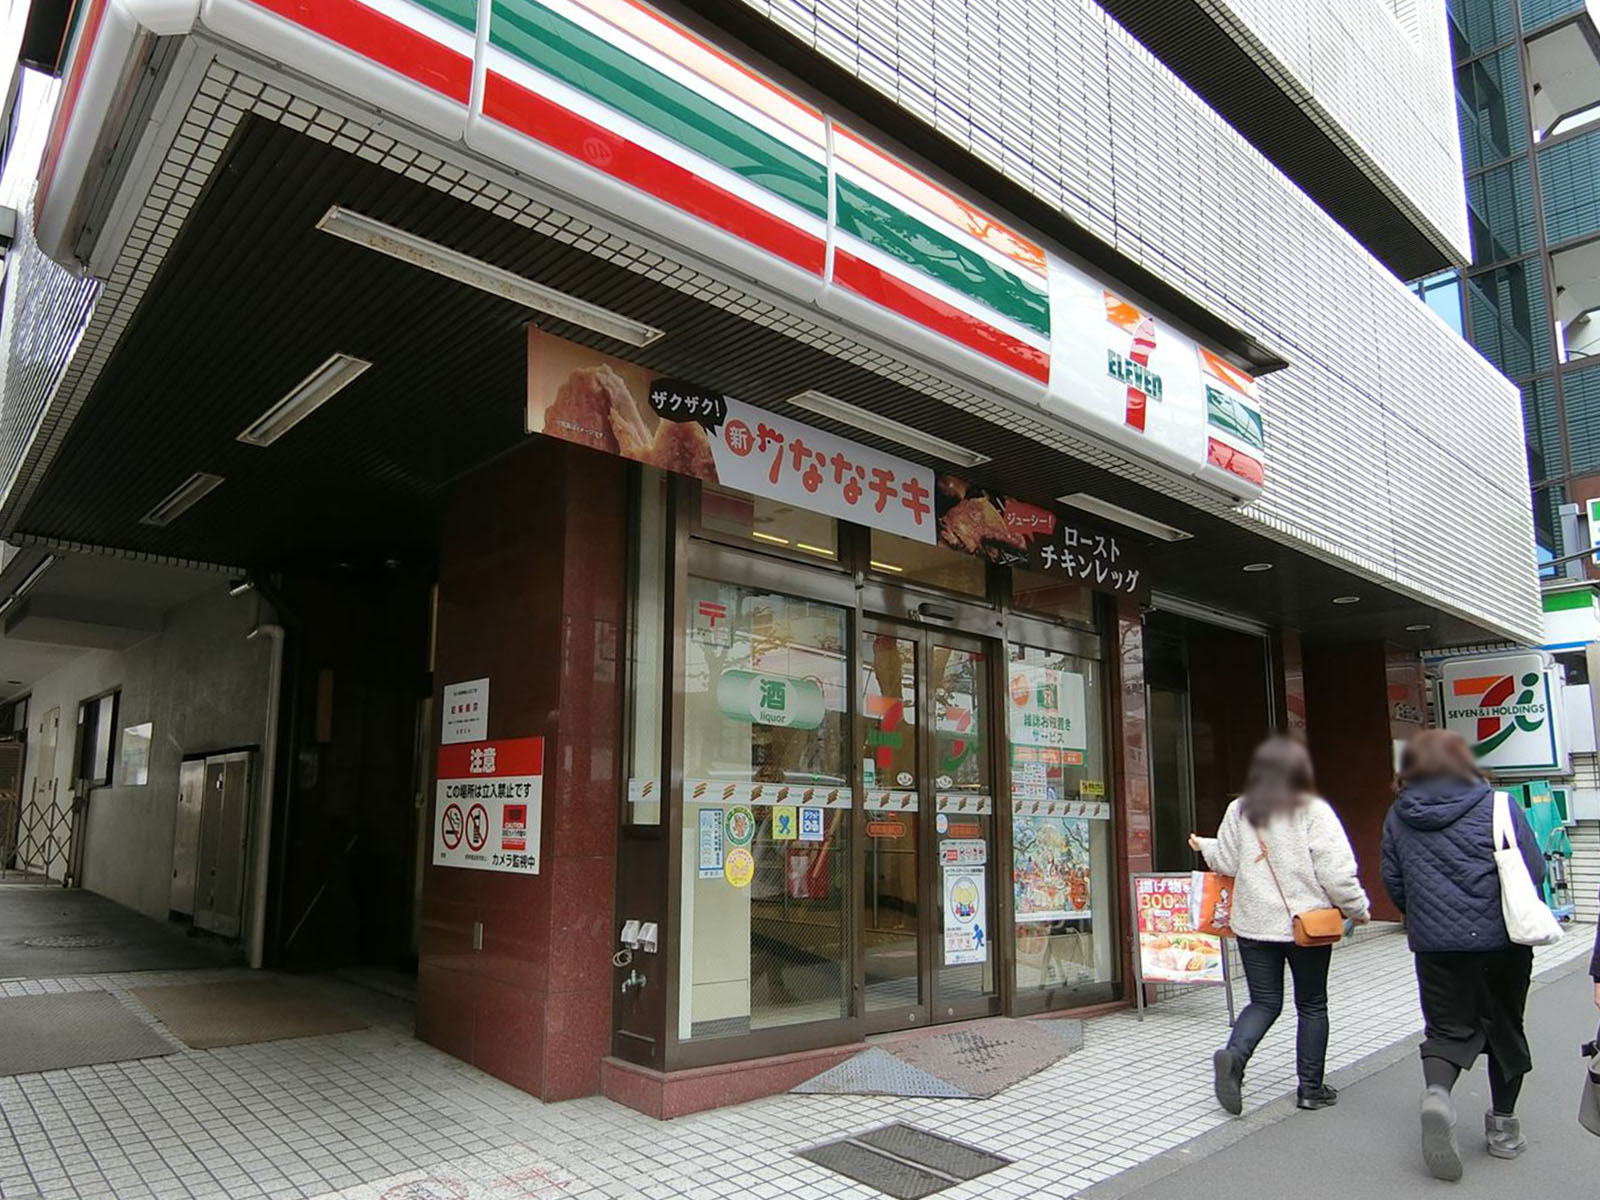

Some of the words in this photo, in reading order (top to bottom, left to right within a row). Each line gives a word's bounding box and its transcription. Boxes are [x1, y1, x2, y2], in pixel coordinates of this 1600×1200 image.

[1107, 349, 1163, 402] ELEVEN
[651, 390, 721, 418] ザクザク!
[730, 426, 748, 450] 新
[1007, 512, 1053, 528] ジューシー!
[1064, 526, 1121, 563] ロースト
[1040, 545, 1140, 593] チキンレッグ
[760, 678, 786, 711] 酒
[760, 711, 786, 724] liquor
[1492, 704, 1545, 717] HOLDINGS
[469, 747, 497, 774] 注意
[446, 782, 532, 799] この場所は立入禁止です
[492, 853, 536, 870] カメラ監視中
